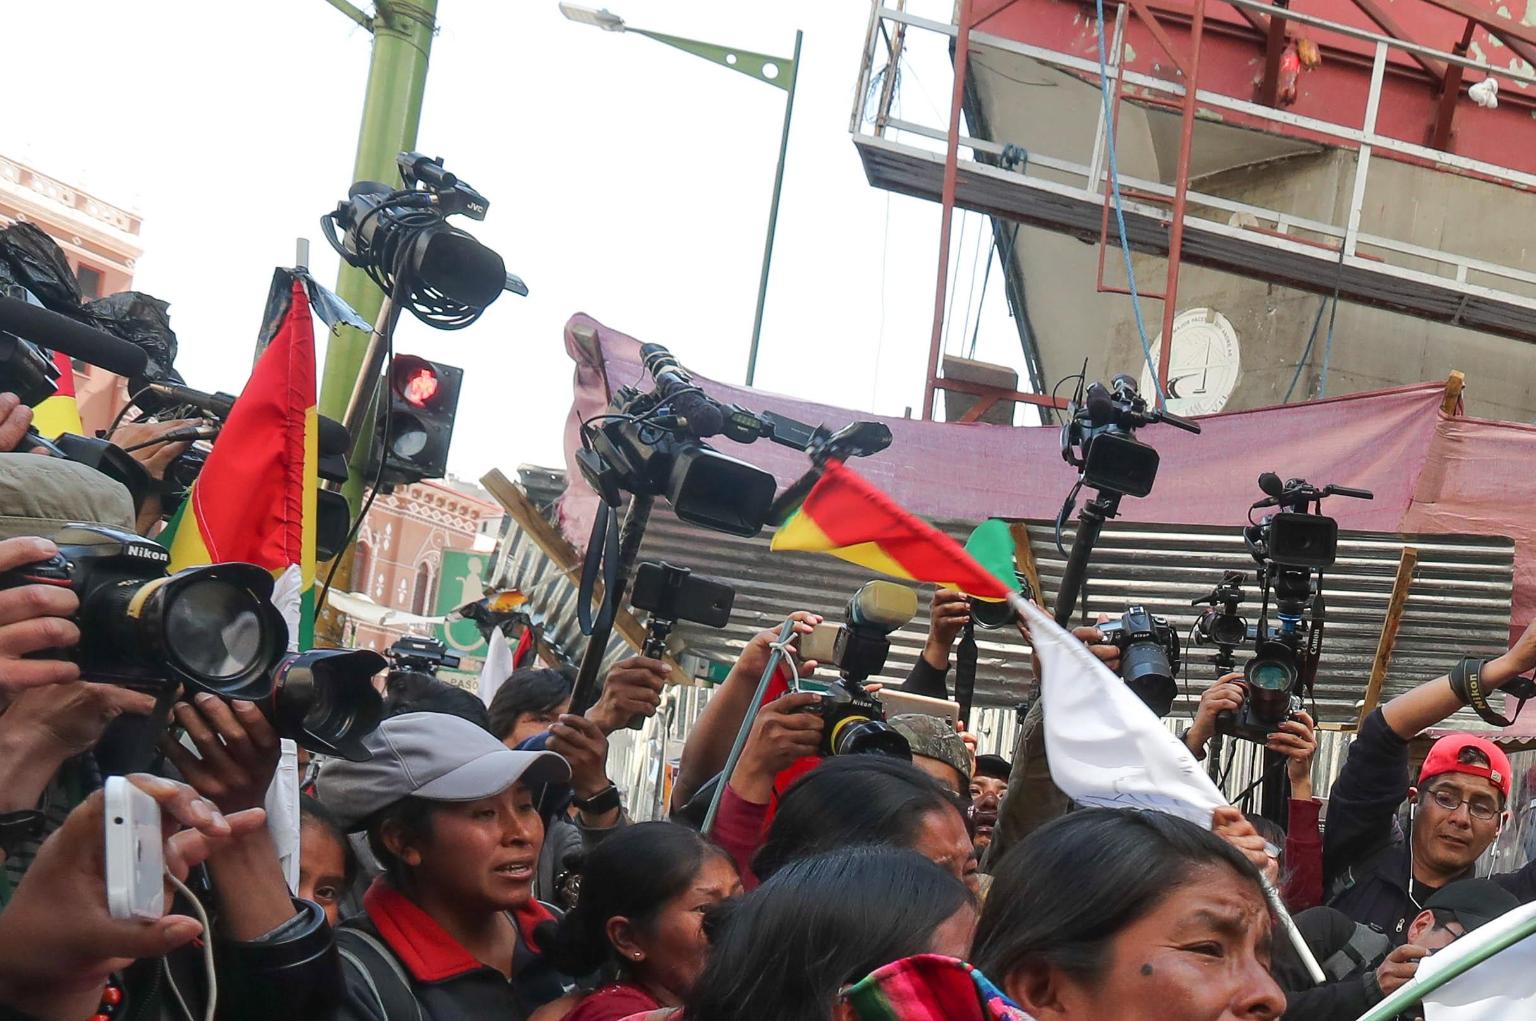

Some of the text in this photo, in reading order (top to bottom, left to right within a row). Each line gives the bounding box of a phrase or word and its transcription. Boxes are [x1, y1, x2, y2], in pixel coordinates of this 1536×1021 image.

[467, 202, 484, 213] JVC
[127, 545, 168, 562] Nikon
[1310, 629, 1320, 655] Canon
[1469, 673, 1486, 709] Nikon
[852, 699, 872, 708] Nikon
